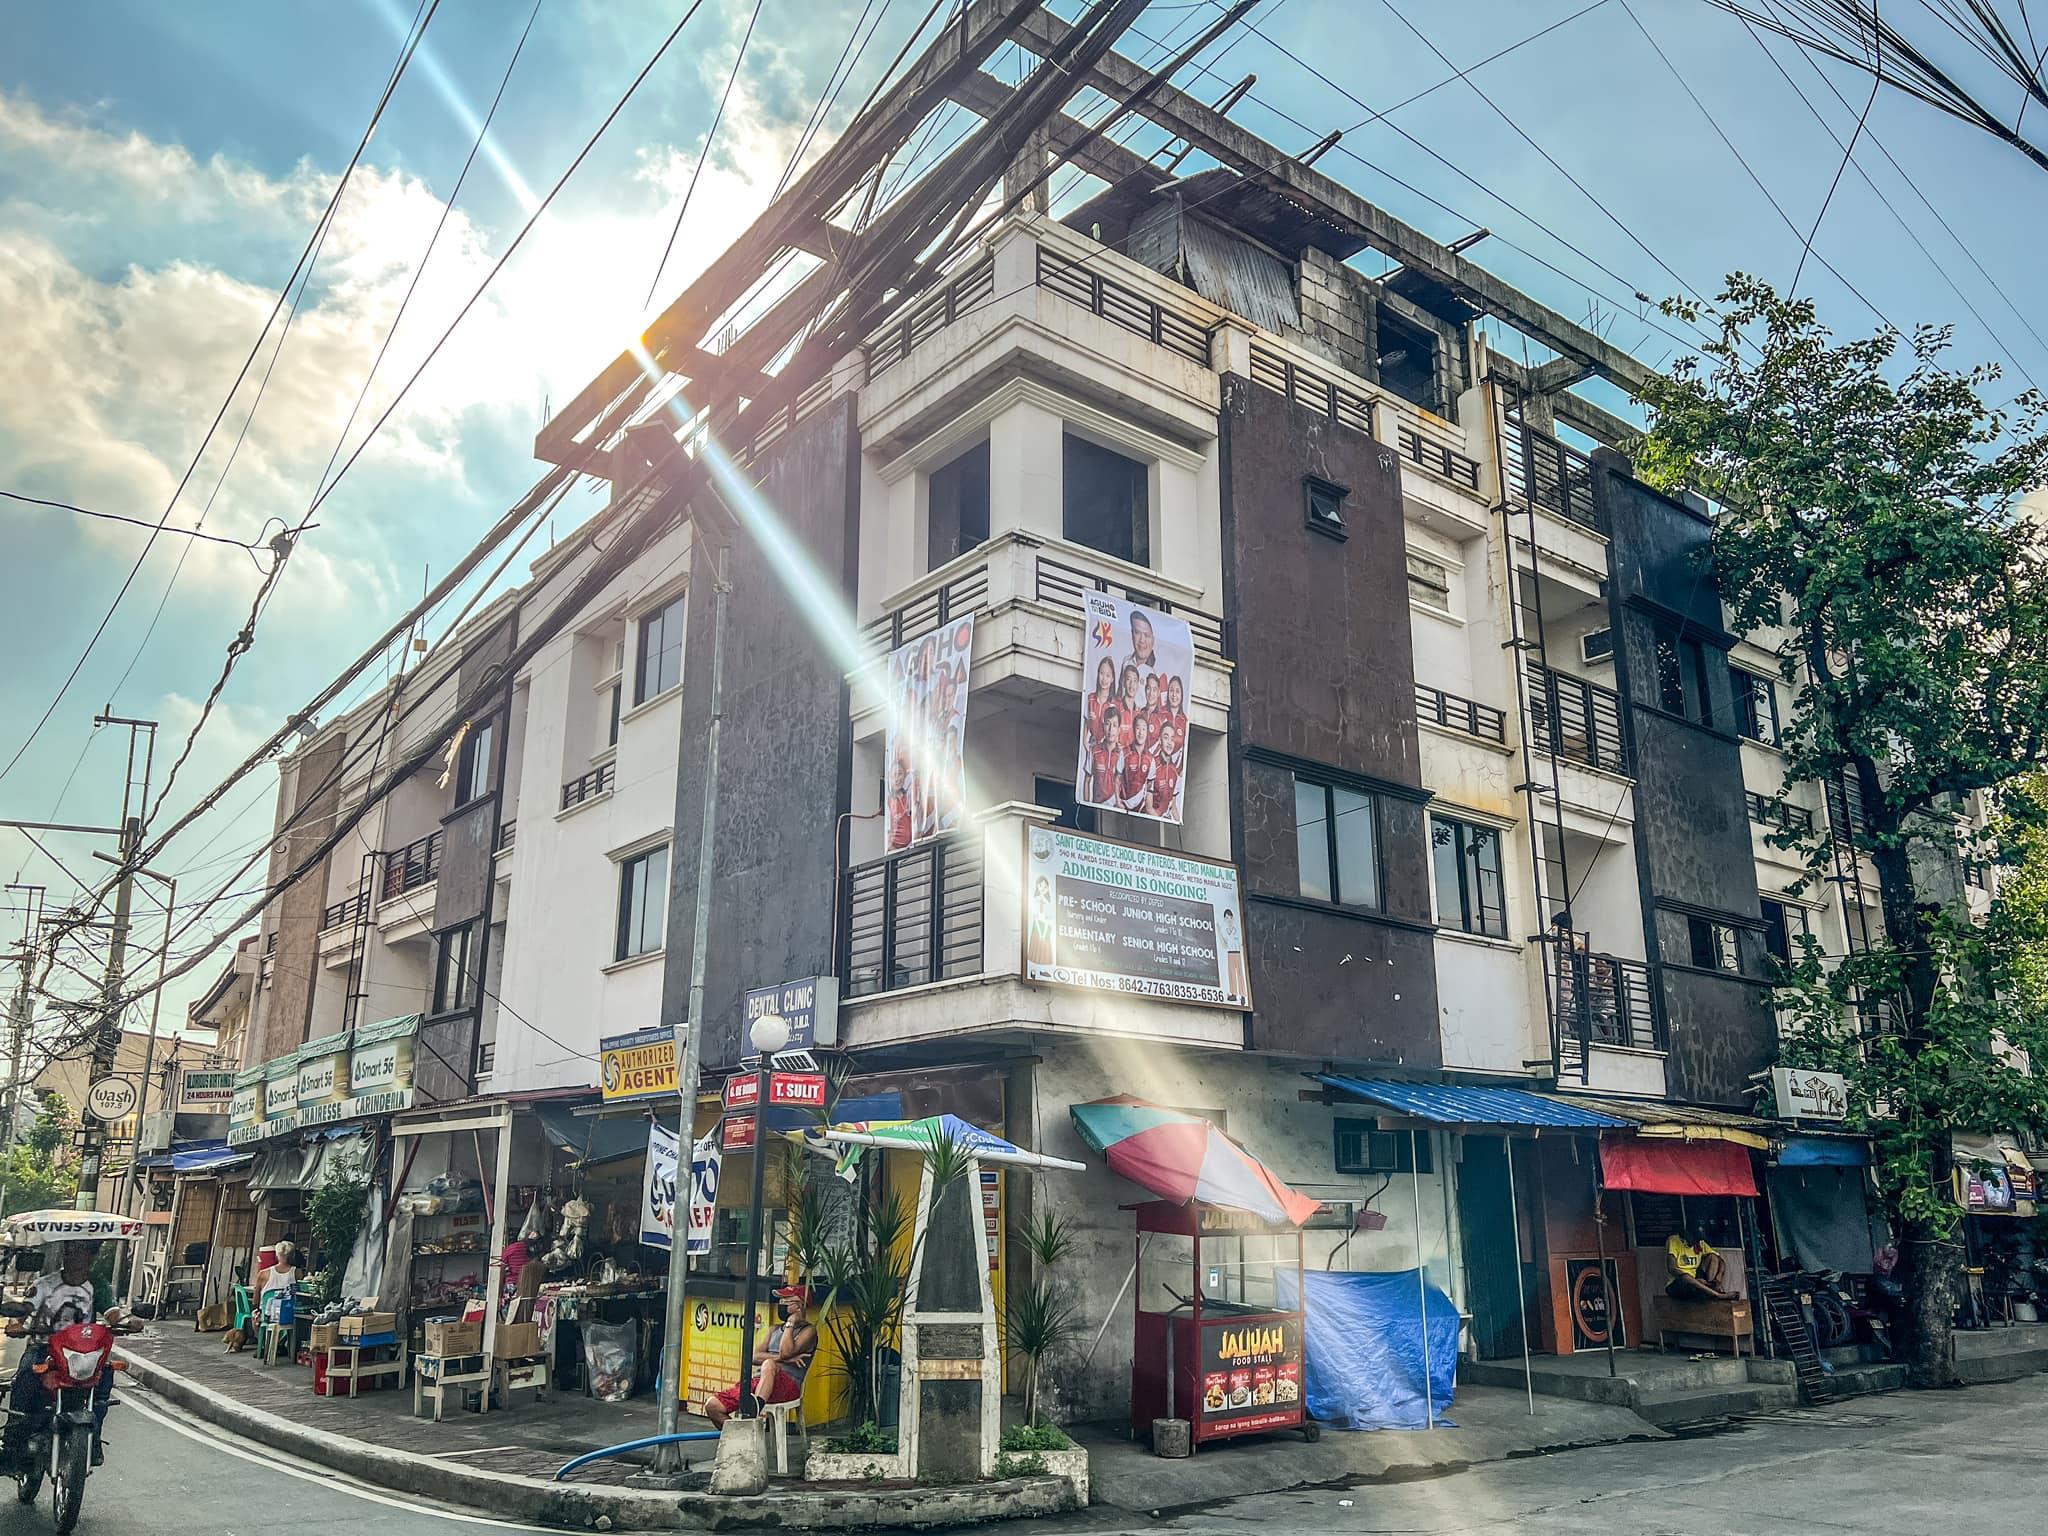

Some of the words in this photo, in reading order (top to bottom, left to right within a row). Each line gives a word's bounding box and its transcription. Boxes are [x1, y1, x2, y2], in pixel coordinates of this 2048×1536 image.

[1056, 834, 1074, 849] SAINT
[1076, 838, 1109, 857] GENEVIEVE
[1112, 846, 1136, 862] SCHOOL
[1137, 853, 1146, 865] OF
[1179, 860, 1199, 875] METRO
[1062, 861, 1132, 887] ADMISSION
[1136, 876, 1148, 890] IS
[1149, 879, 1208, 901] ONGOING!
[1080, 898, 1117, 915] SCHOOL
[1122, 907, 1153, 922] JUNIOR
[1156, 912, 1177, 925] HIGH
[1179, 917, 1214, 932] SCHOOL
[1059, 925, 1116, 945] ELEMENTARY
[1122, 936, 1155, 951] SENIOR
[1157, 941, 1178, 955] HIGH
[1181, 945, 1215, 960] SCHOOL
[1071, 971, 1087, 985] Tel
[1119, 977, 1225, 1003] 8642-7763/8353-6536
[748, 993, 780, 1019] DENTAL
[783, 986, 813, 1012] CLINIC
[361, 1059, 381, 1078] Smart
[383, 1057, 394, 1074] 5G
[621, 1045, 674, 1069] AUTHORIZED
[306, 1075, 324, 1091] Smart
[324, 1070, 333, 1086] 5G
[623, 1067, 675, 1090] AGENT
[274, 1088, 291, 1104] Smart
[776, 1082, 784, 1097] T.
[786, 1083, 820, 1099] SULIT
[300, 1102, 342, 1125] JHAIRESSE
[355, 1091, 405, 1115] CARINDERIA
[1232, 1357, 1251, 1367] FOOD
[1253, 1355, 1273, 1365] STALL
